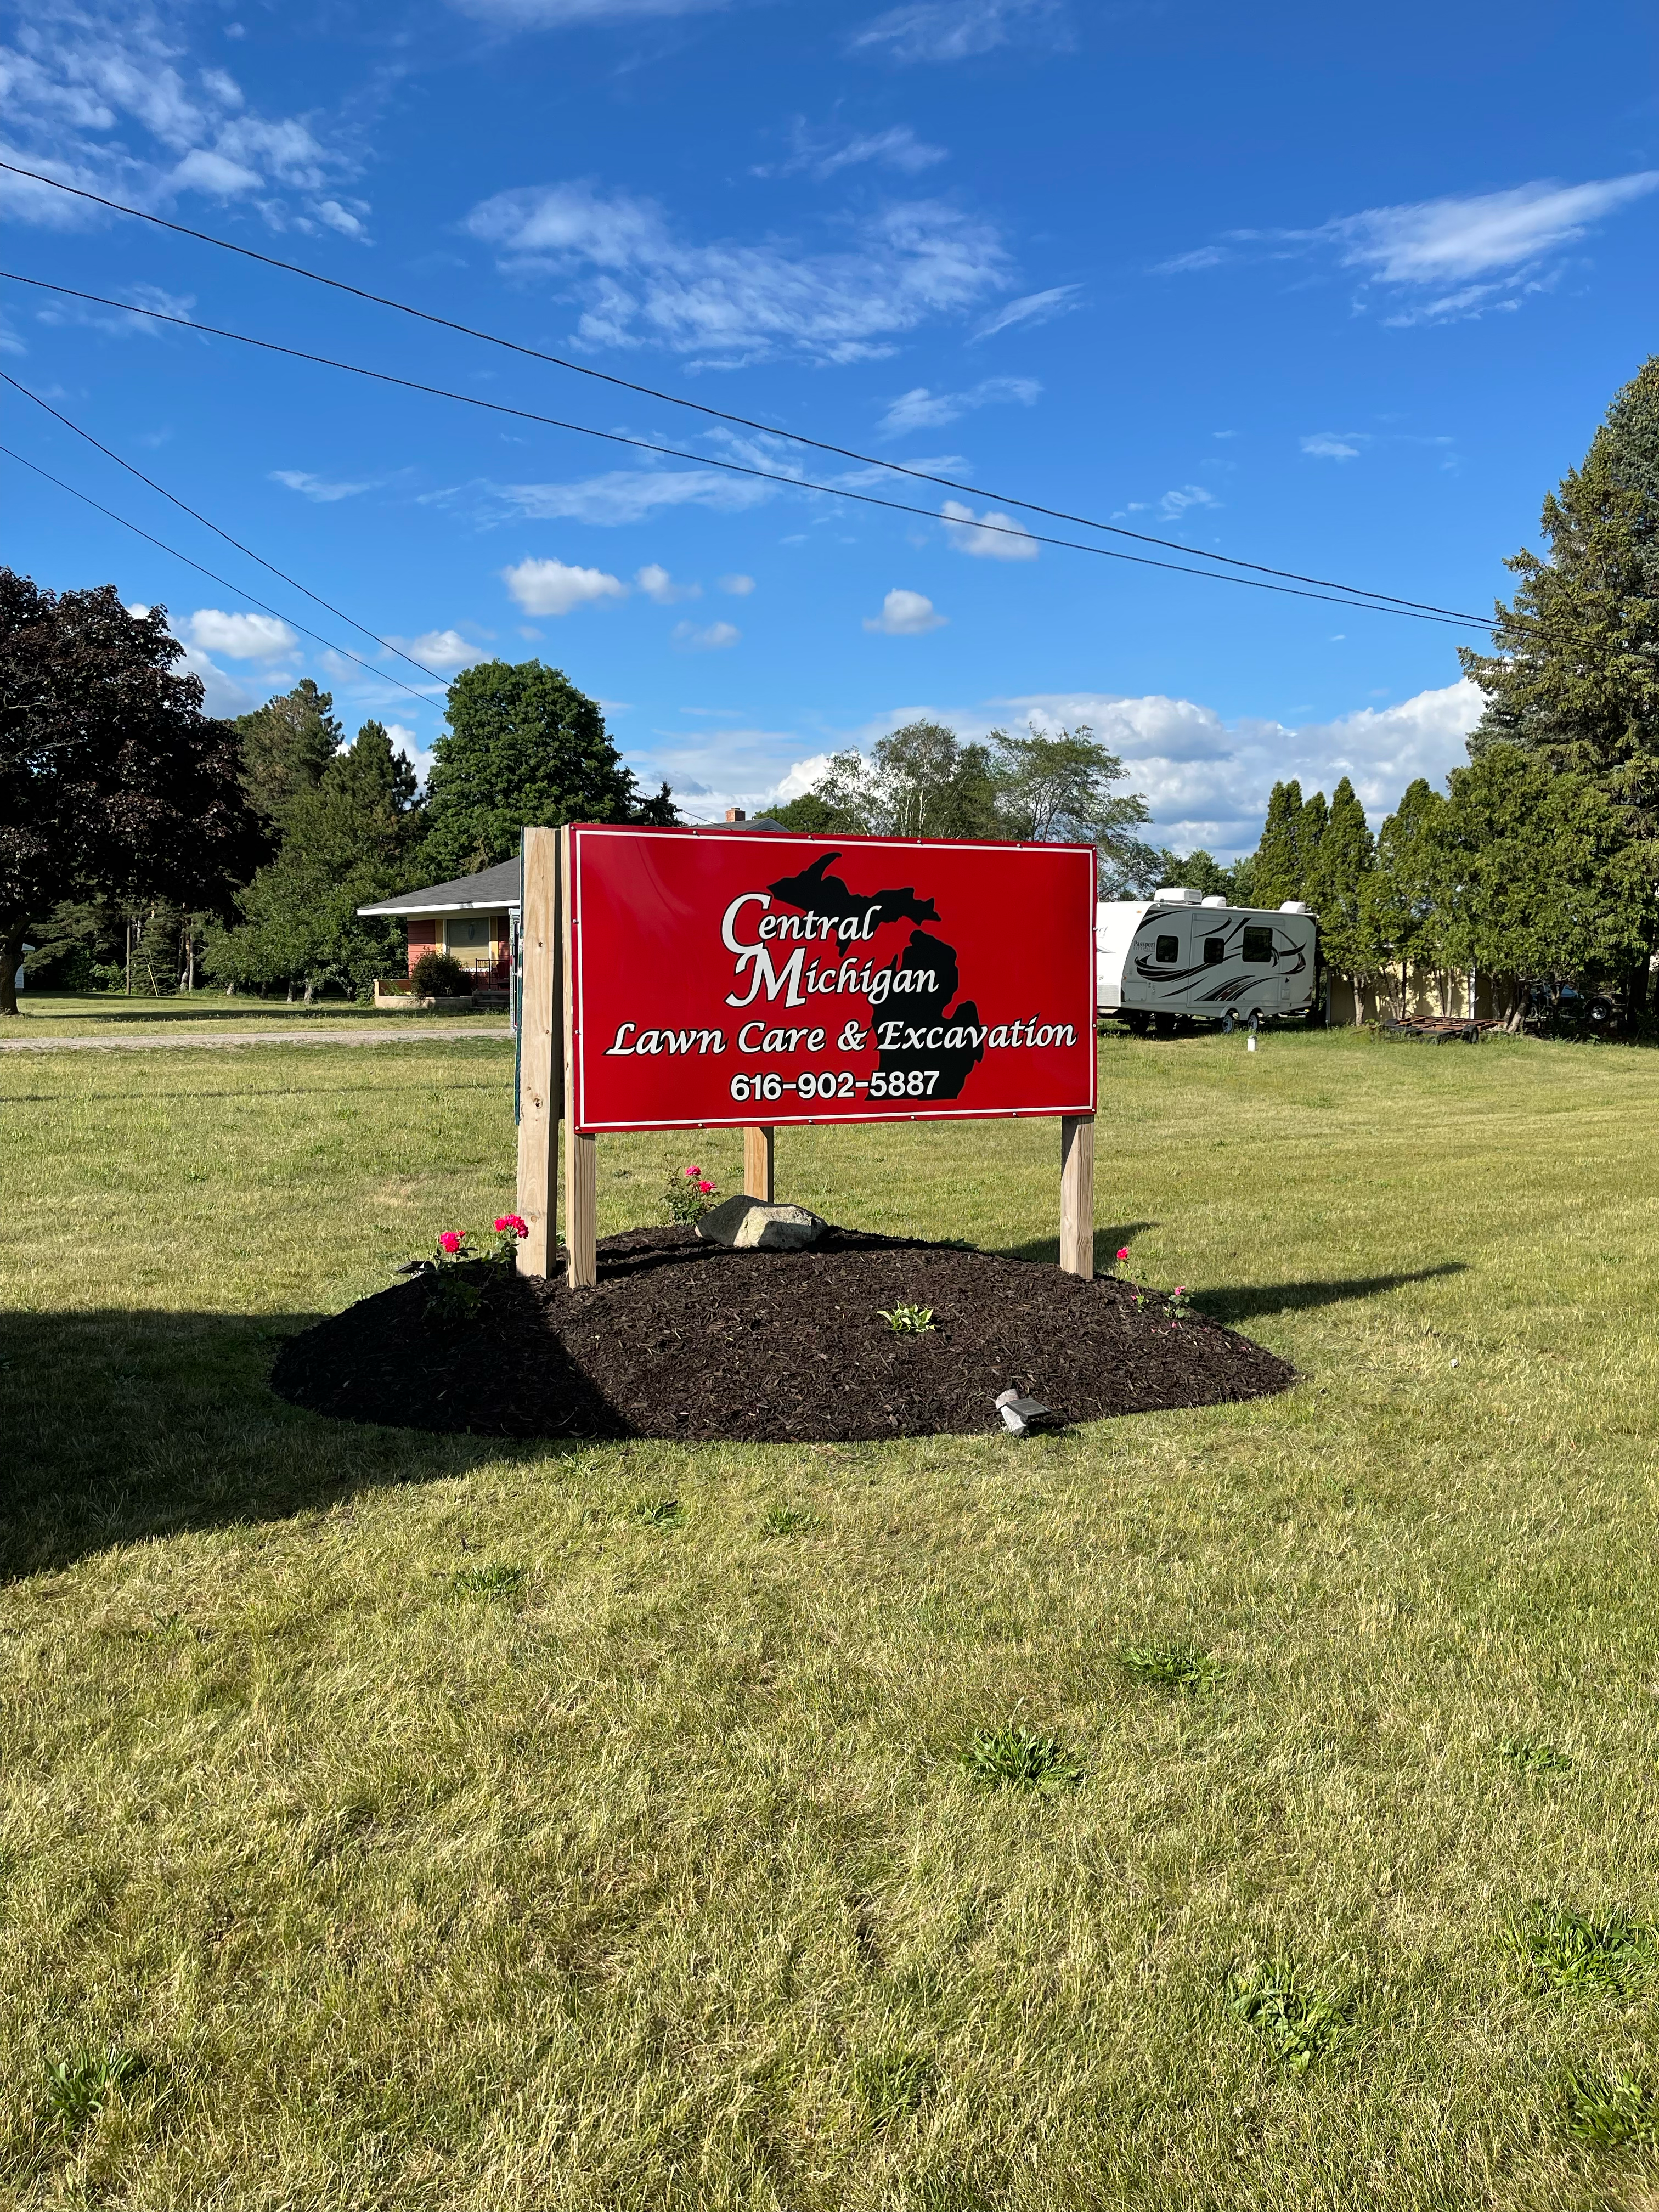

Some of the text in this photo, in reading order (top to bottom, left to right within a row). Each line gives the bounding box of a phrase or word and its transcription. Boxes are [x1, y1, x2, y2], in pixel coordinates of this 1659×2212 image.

[721, 893, 882, 955] Central
[725, 947, 939, 1008] Michigan
[605, 1015, 1077, 1055] Lawn Care & Excavation
[730, 1070, 940, 1101] 616-902-5887
